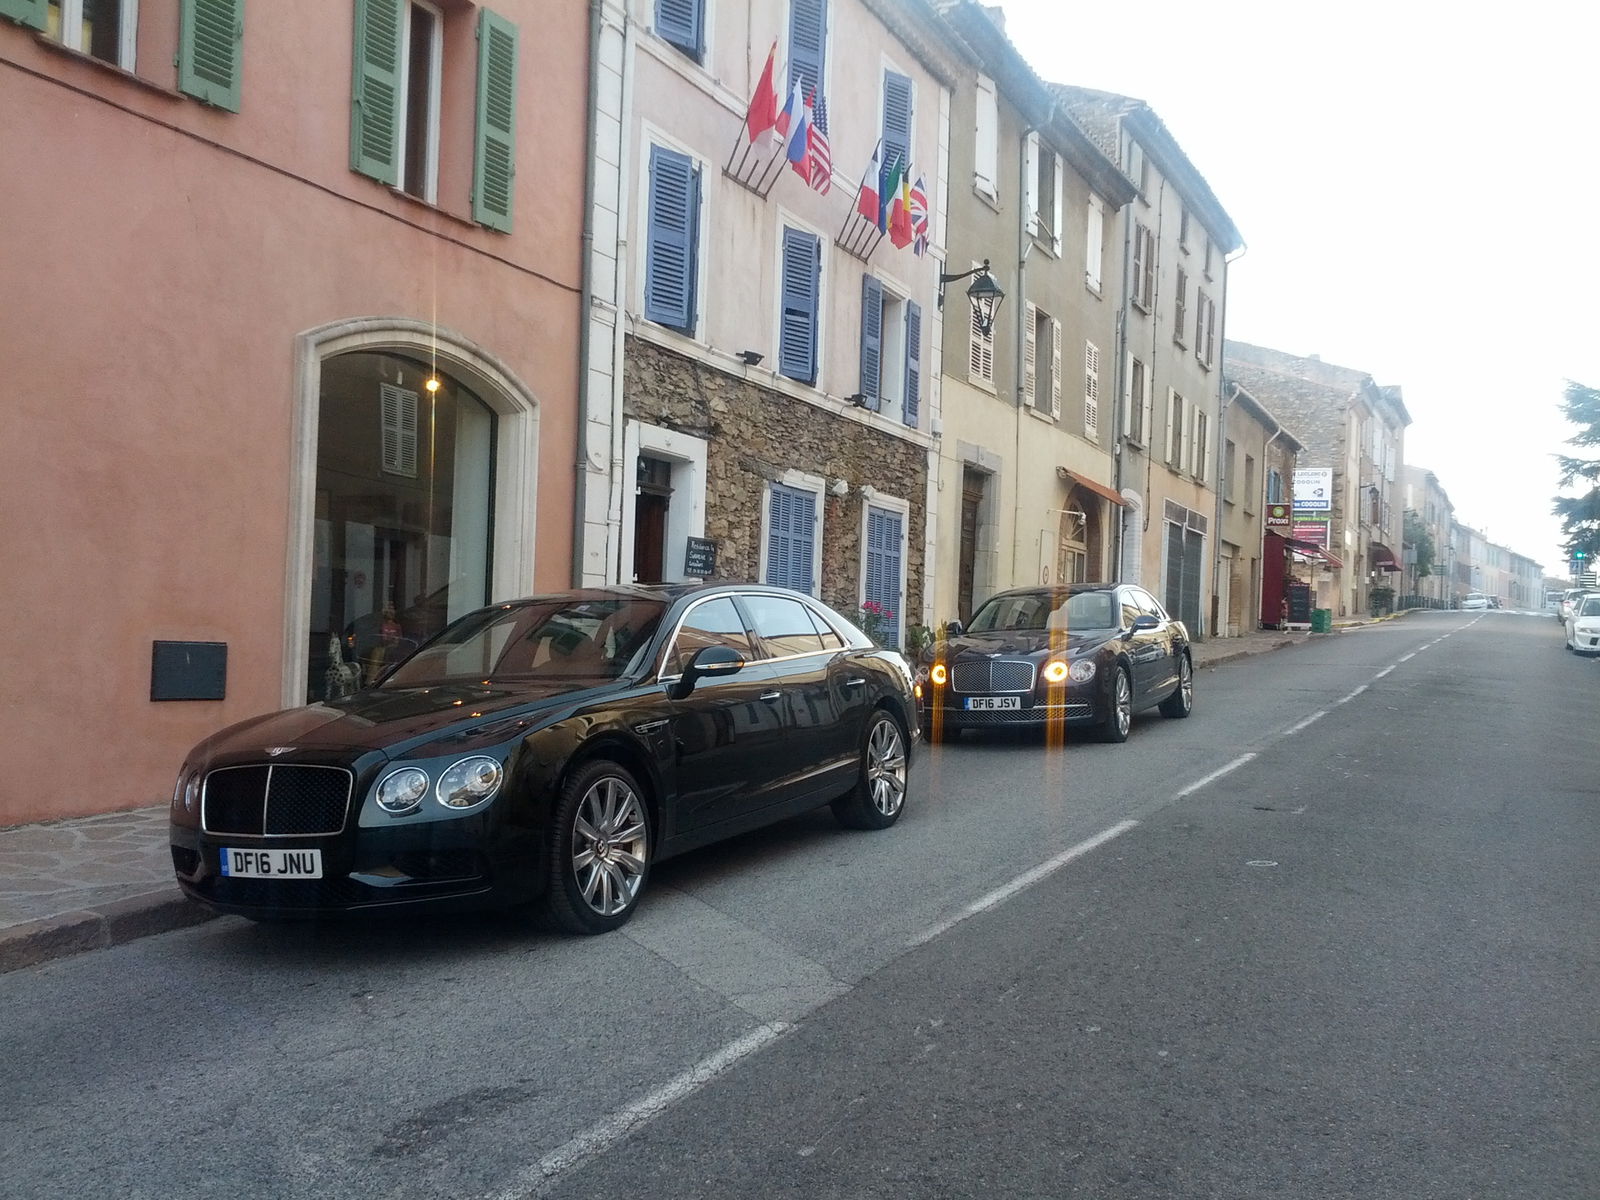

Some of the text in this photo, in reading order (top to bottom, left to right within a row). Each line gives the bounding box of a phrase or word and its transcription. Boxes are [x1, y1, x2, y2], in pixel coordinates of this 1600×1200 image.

[1268, 515, 1289, 524] Proxi
[972, 698, 1017, 709] DF16 JSV
[233, 852, 315, 874] DF16 JNU
